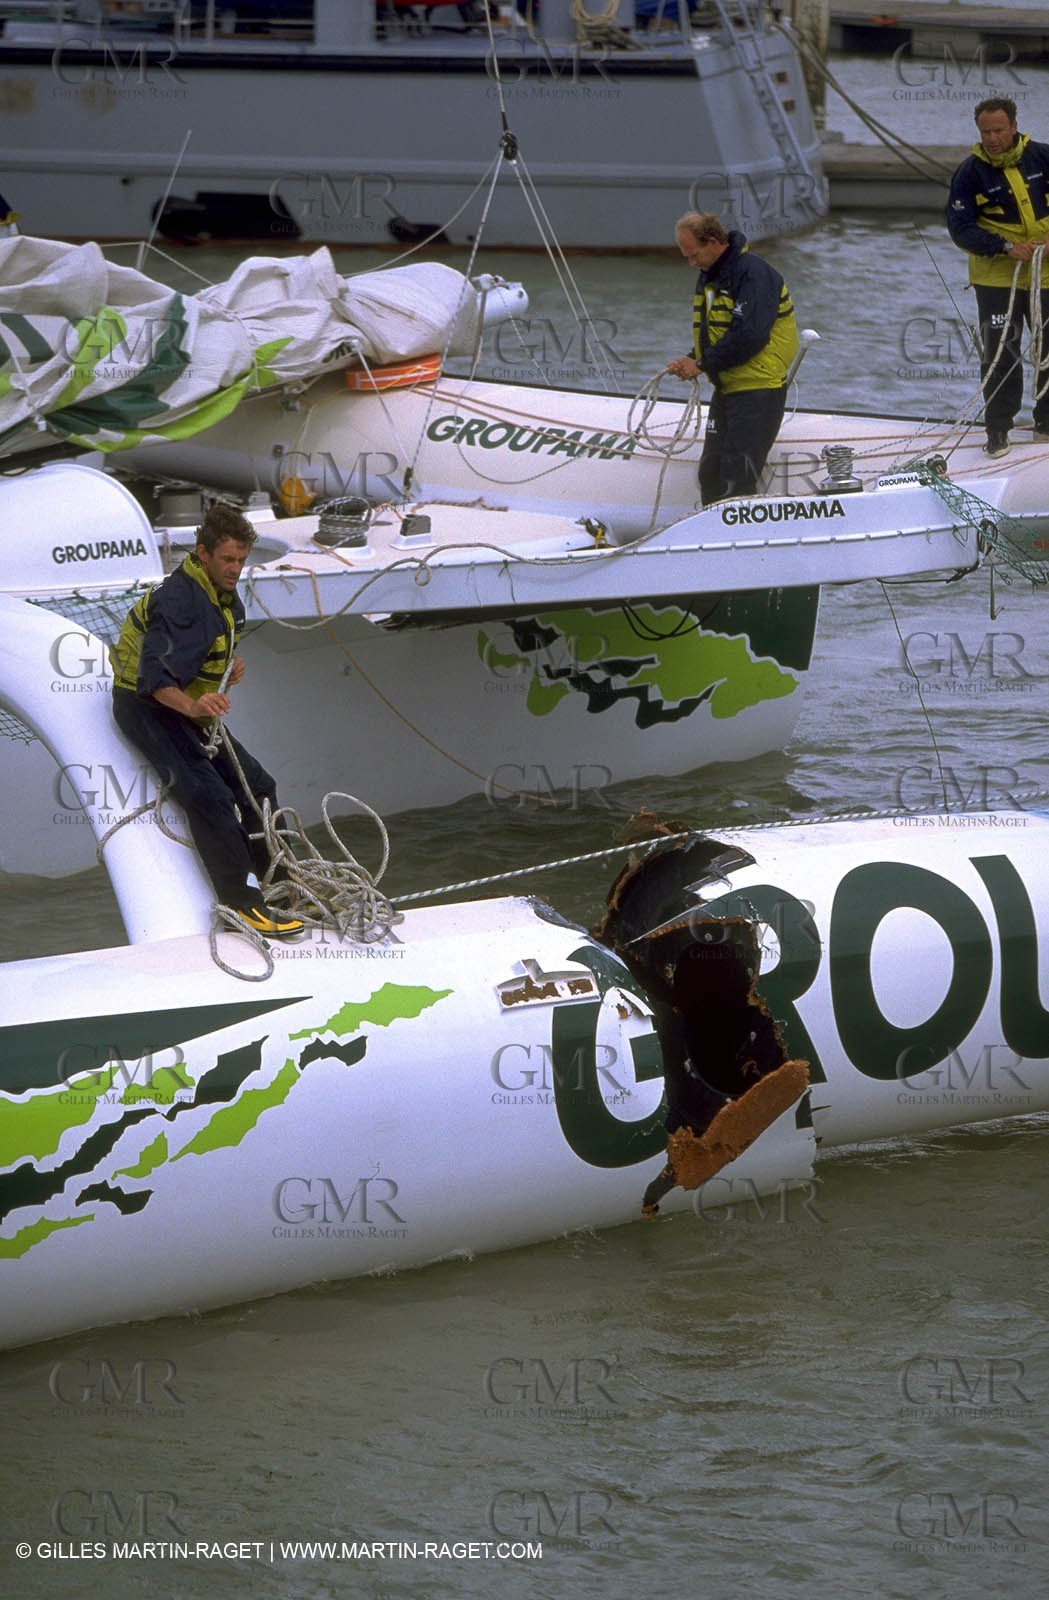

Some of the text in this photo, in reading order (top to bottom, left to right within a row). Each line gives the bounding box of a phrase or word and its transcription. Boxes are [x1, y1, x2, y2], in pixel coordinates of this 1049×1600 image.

[426, 415, 639, 461] GROUPAMA
[878, 475, 920, 487] GROUPAMA
[722, 499, 845, 526] GROUPAMA
[52, 538, 147, 564] GROUPAMA
